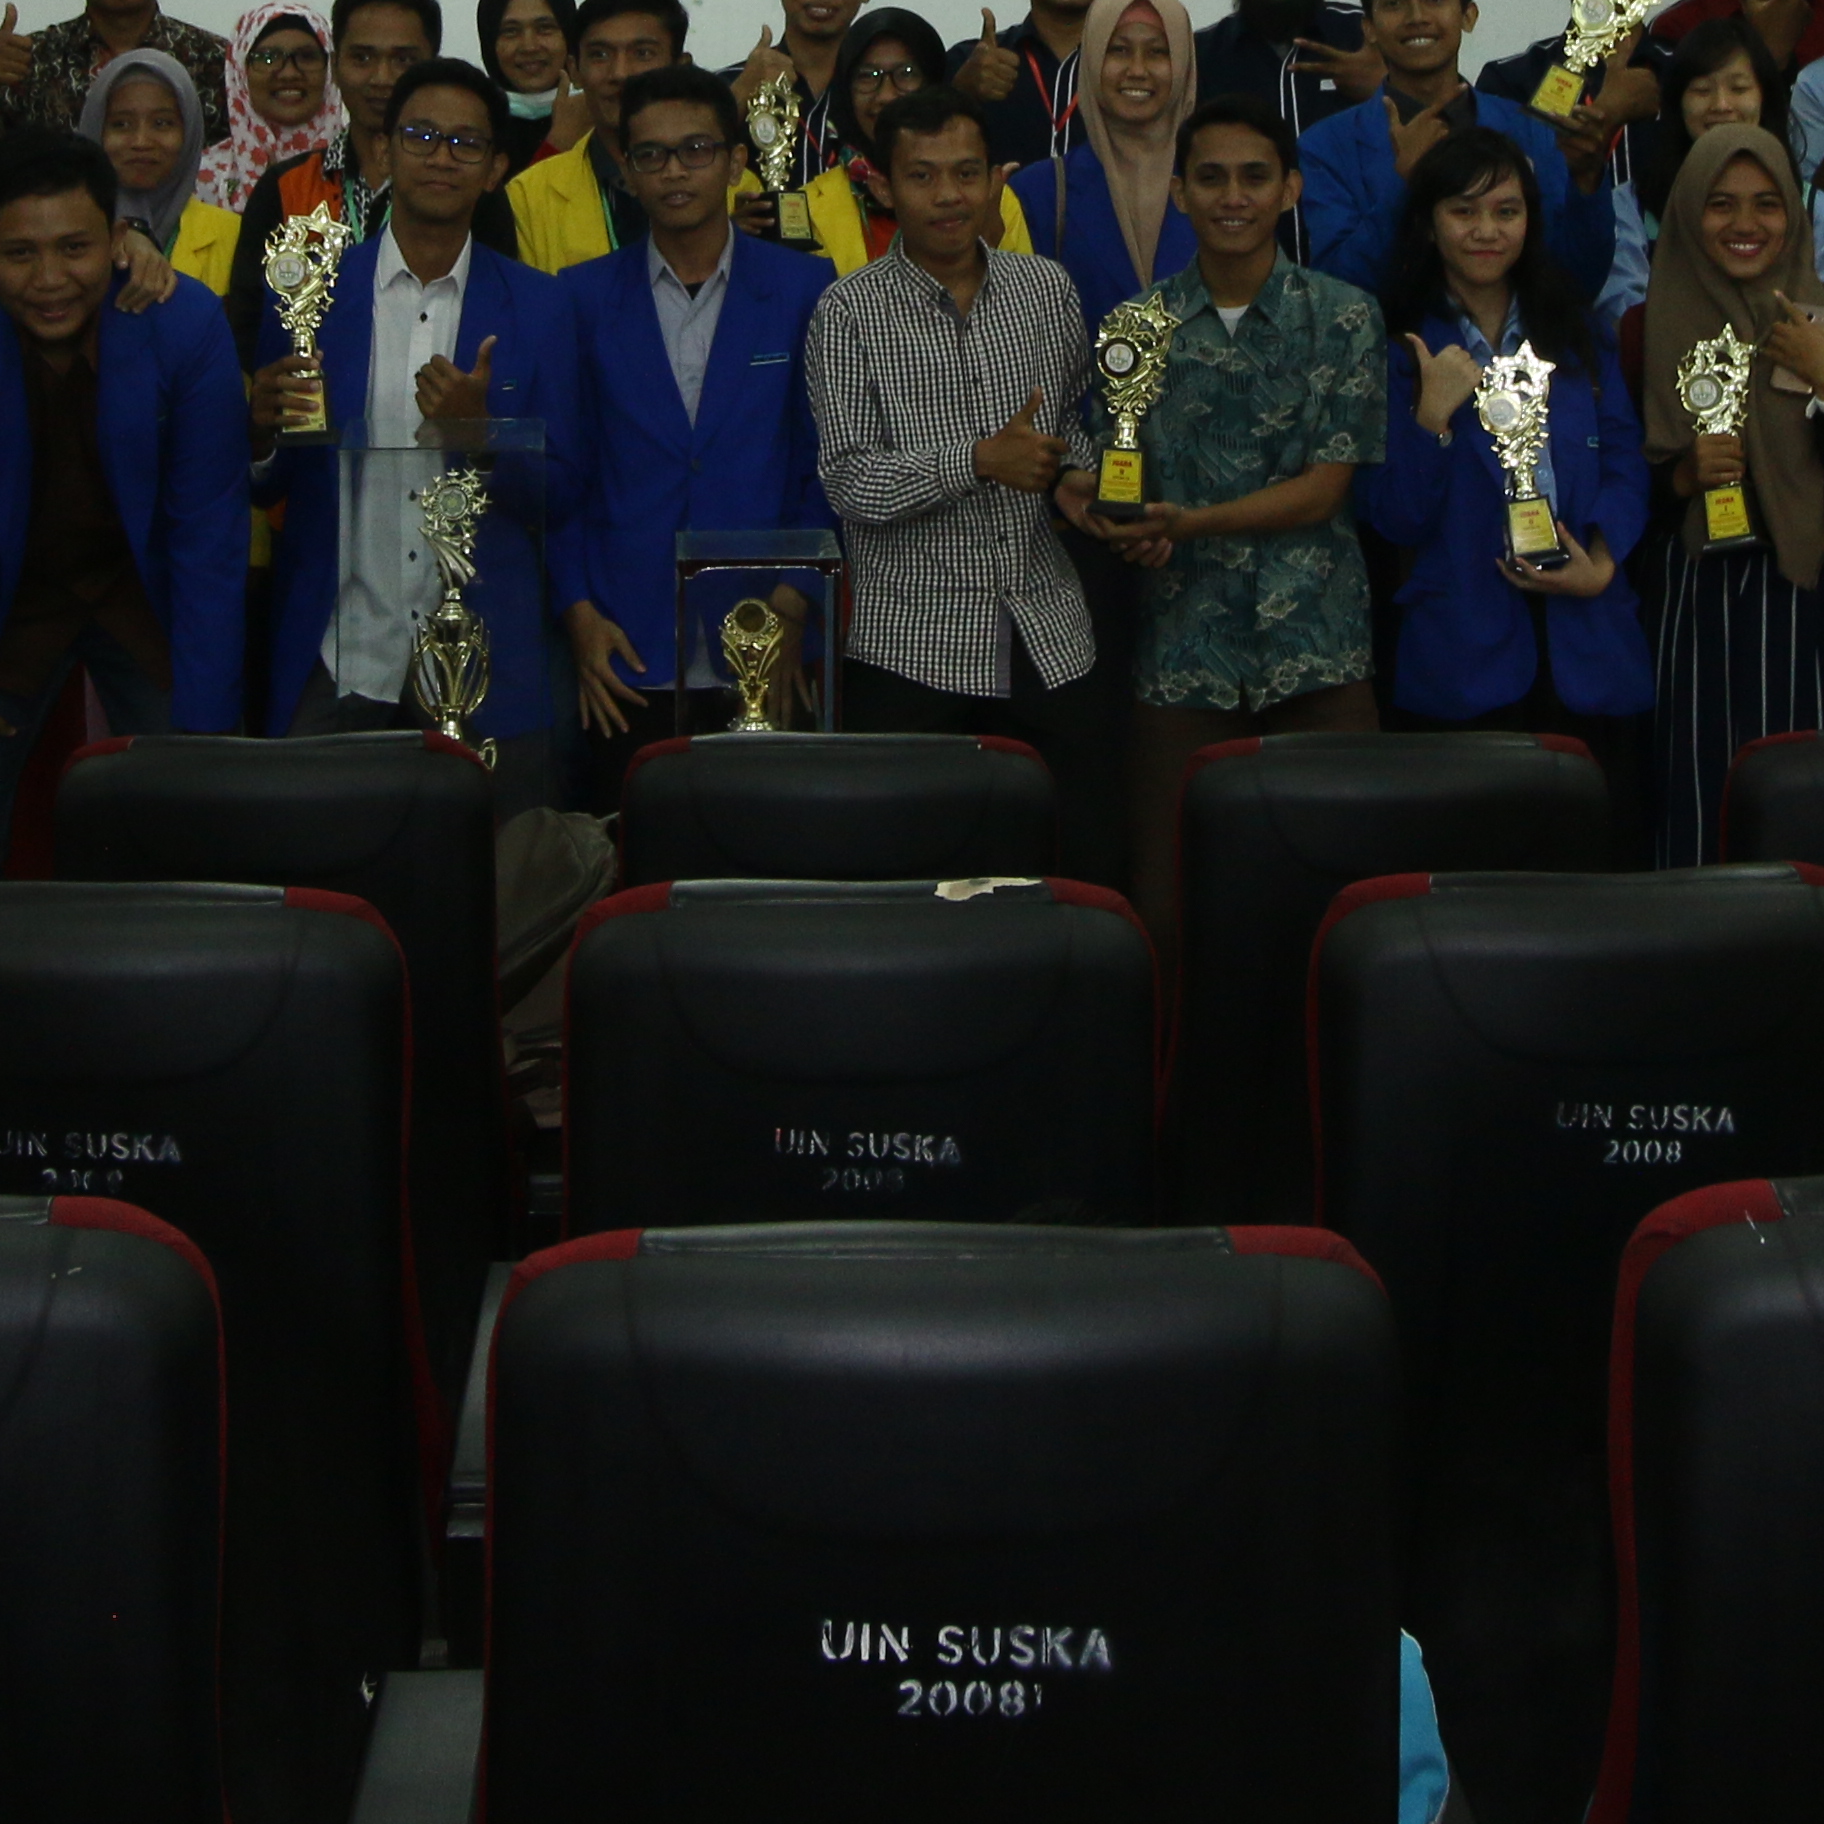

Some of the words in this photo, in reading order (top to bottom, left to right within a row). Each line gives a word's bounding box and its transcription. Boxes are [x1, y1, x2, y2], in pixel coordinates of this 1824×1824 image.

[1555, 1100, 1613, 1130] UIN
[1625, 1102, 1737, 1135] SUSKA
[63, 1131, 183, 1164] SUSKA
[773, 1126, 831, 1157] UIN
[846, 1131, 963, 1166] SUSKA
[1602, 1138, 1684, 1165] 2008
[821, 1165, 906, 1194] 2008
[820, 1618, 912, 1664] UIN
[936, 1623, 1114, 1674] SUSKA
[896, 1676, 1028, 1719] 2008
